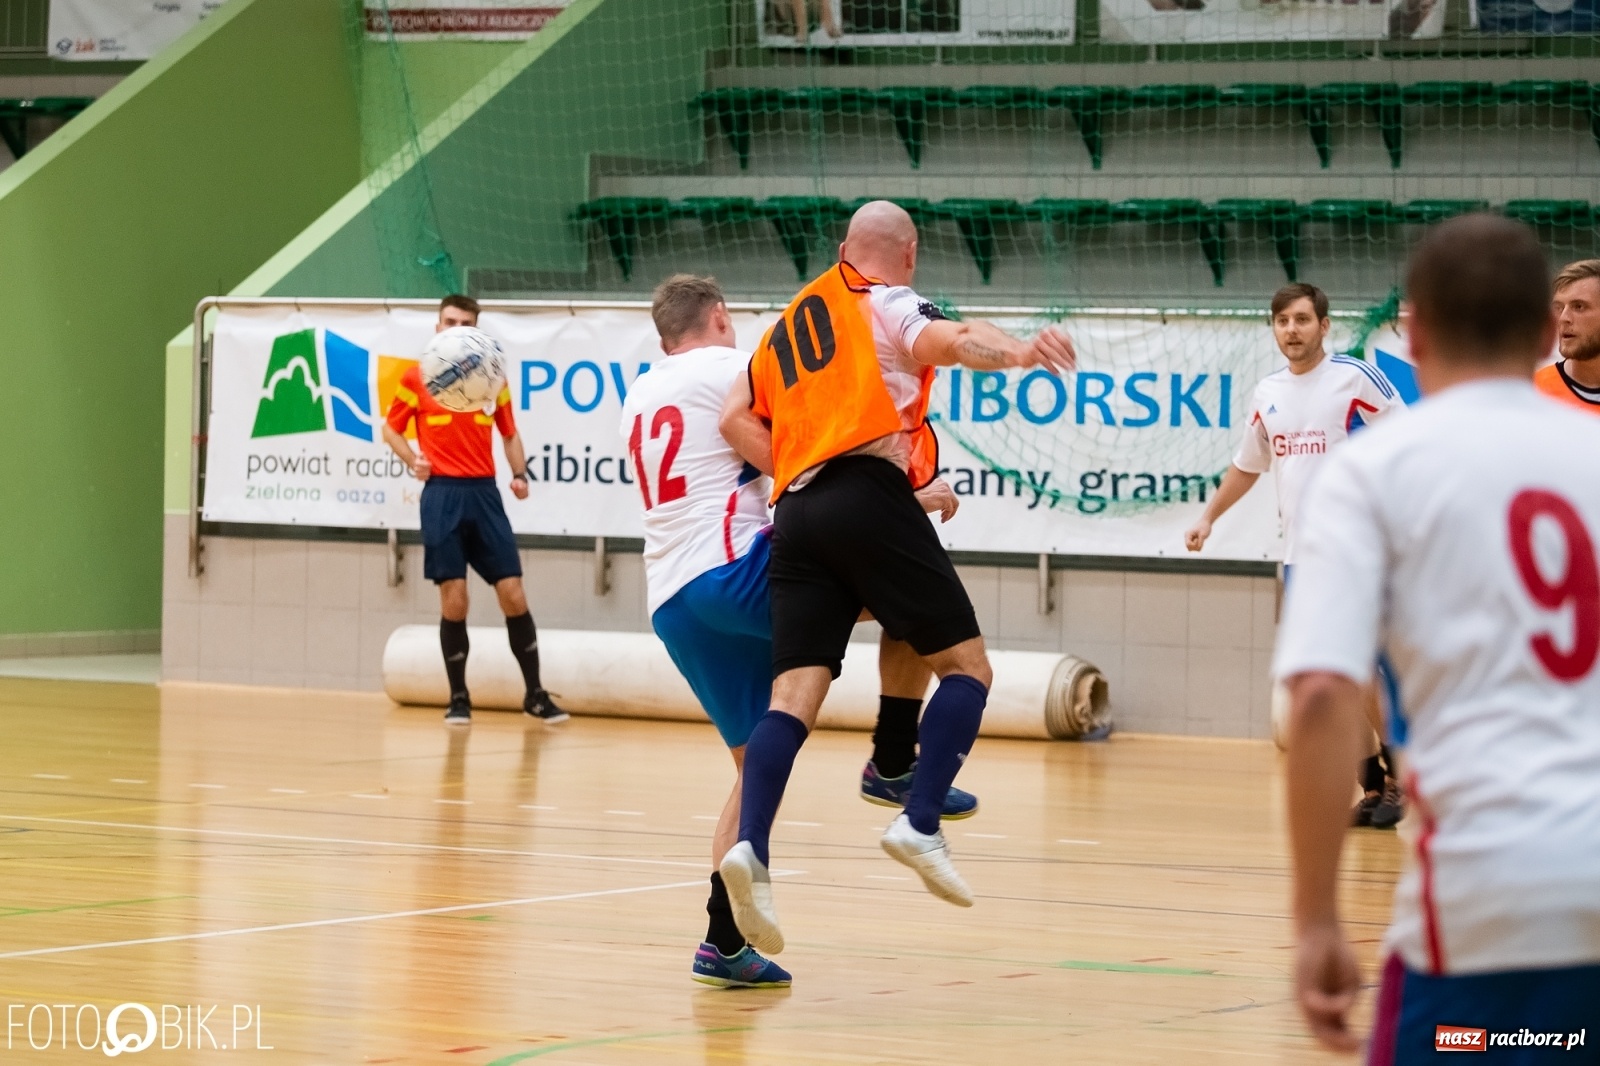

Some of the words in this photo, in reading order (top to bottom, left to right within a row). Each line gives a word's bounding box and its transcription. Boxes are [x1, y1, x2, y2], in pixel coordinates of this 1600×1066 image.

[768, 295, 836, 390] 10
[928, 369, 1232, 429] IBORSKI
[247, 449, 331, 479] powiat
[628, 405, 688, 511] 12
[1273, 435, 1327, 457] Gianni
[246, 483, 321, 502] zielona
[336, 488, 386, 504] oaza
[1077, 469, 1222, 514] gram
[1508, 487, 1600, 684] 9
